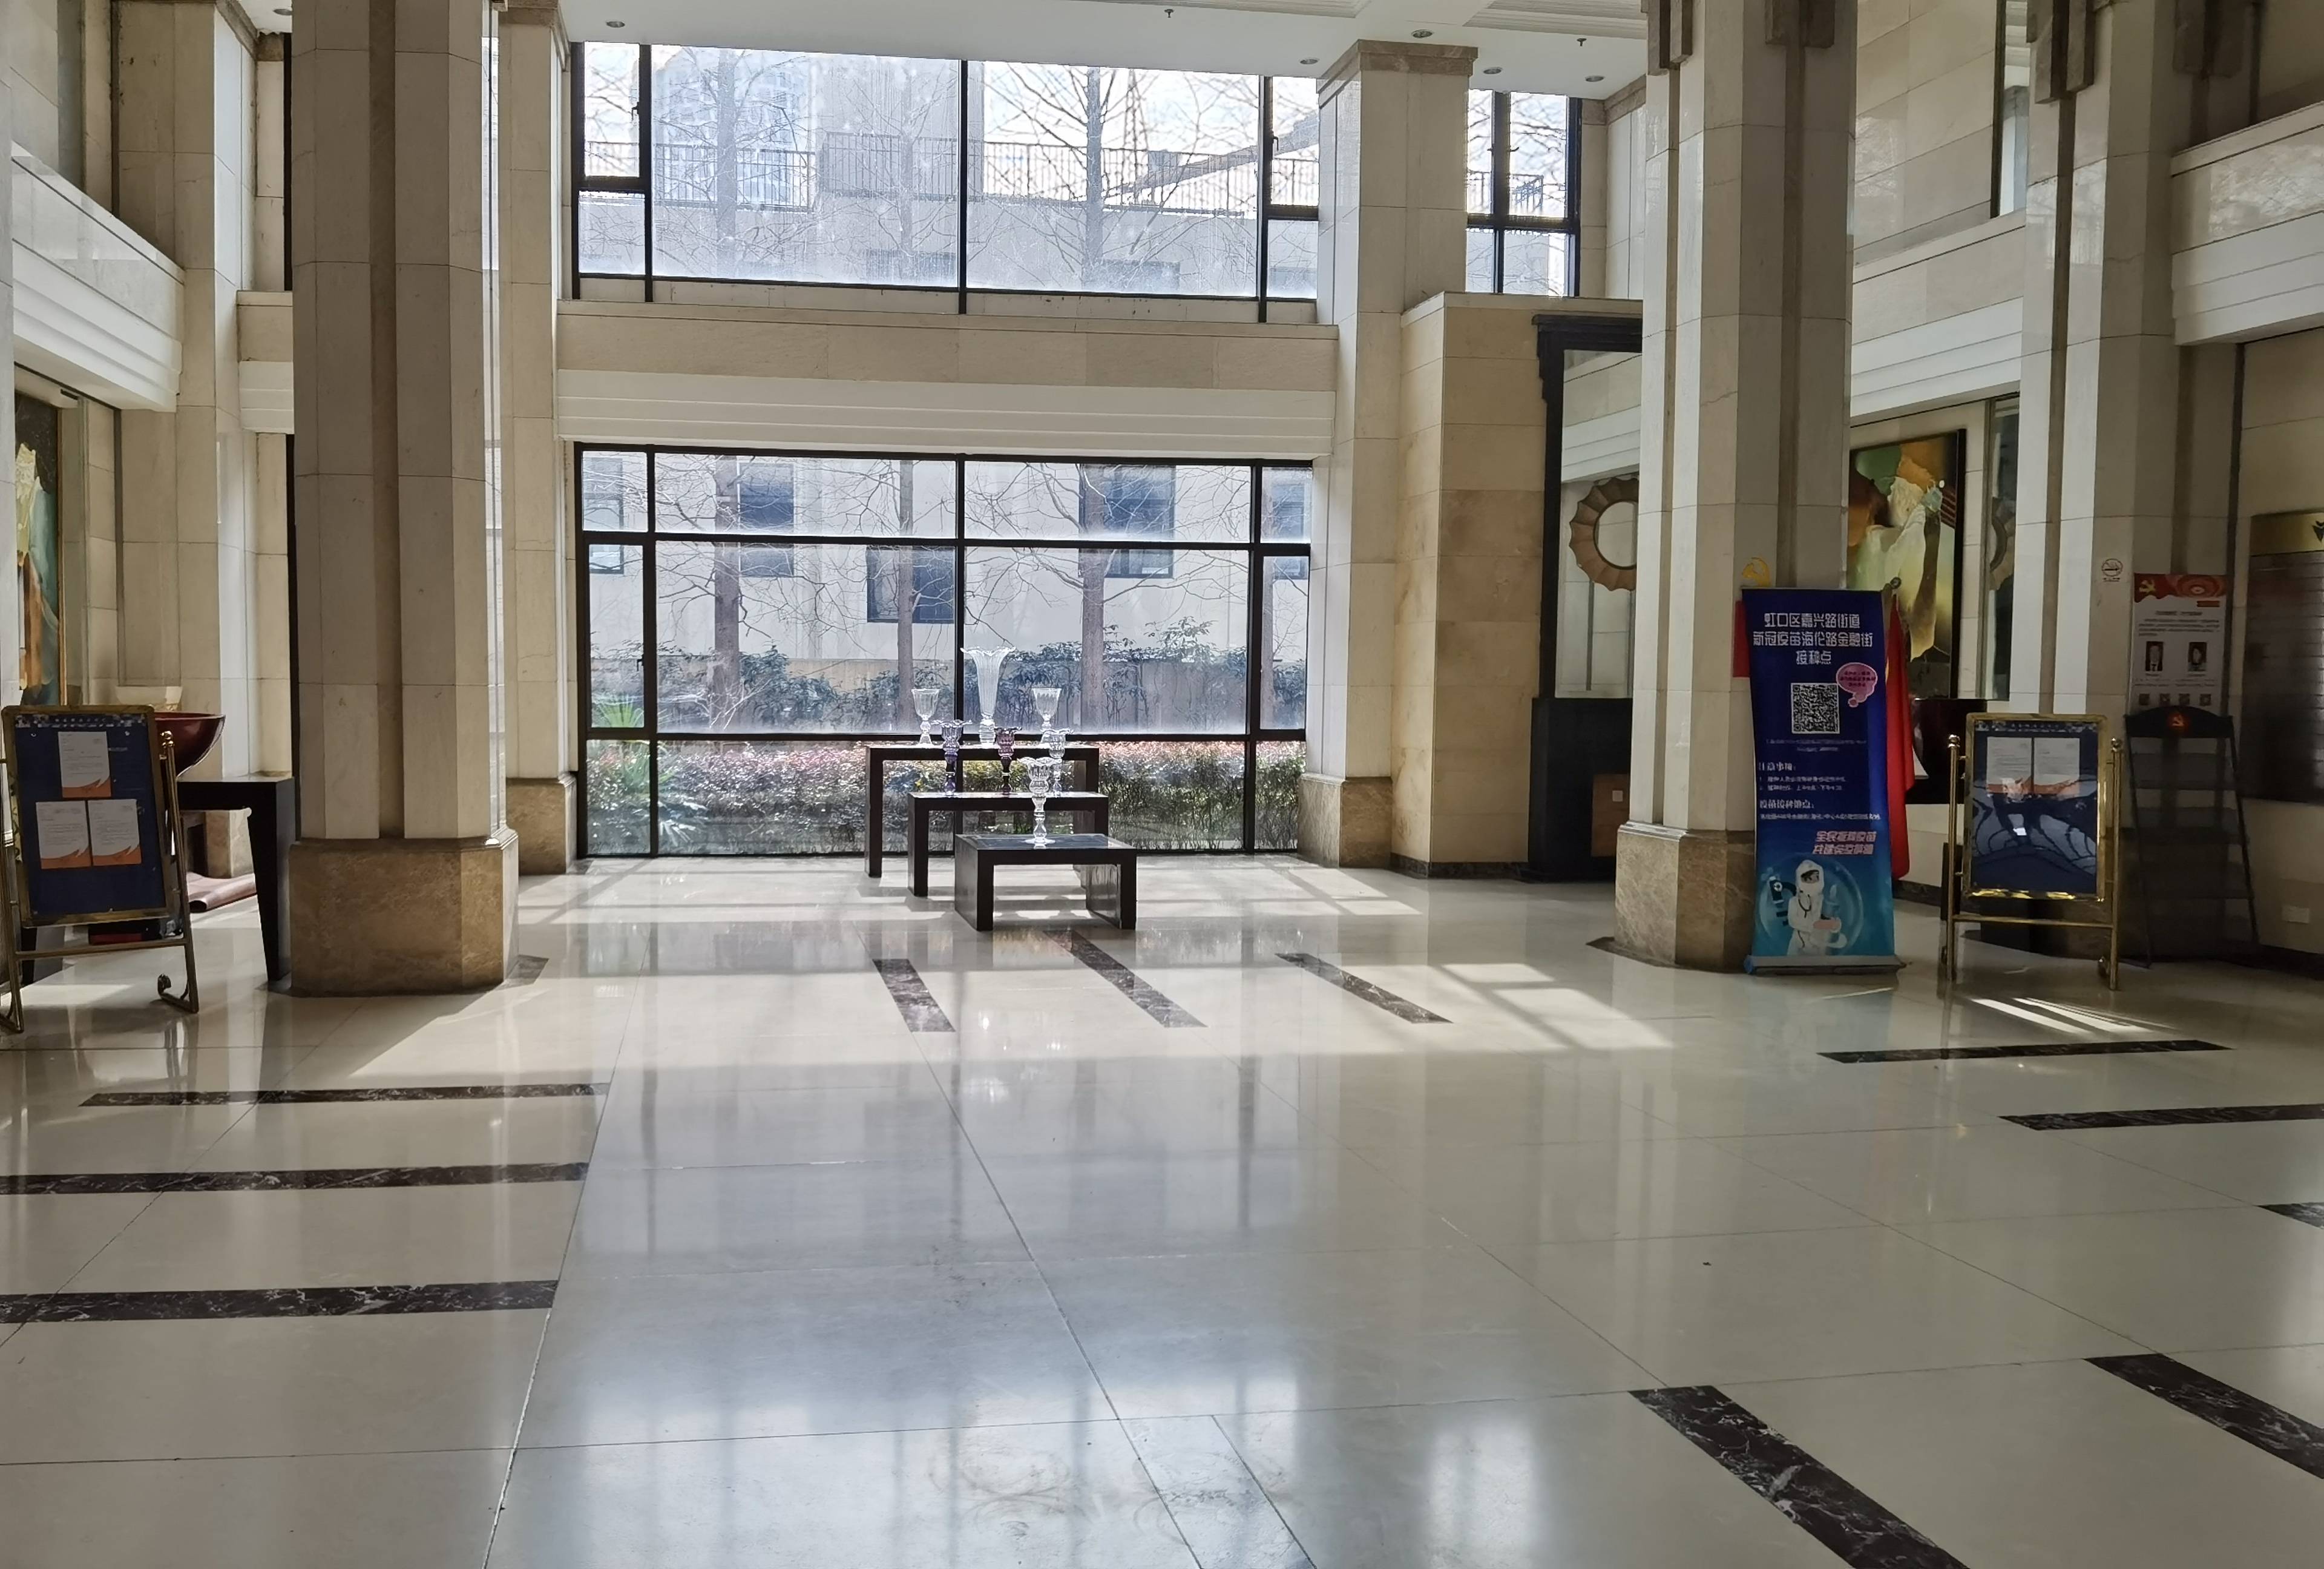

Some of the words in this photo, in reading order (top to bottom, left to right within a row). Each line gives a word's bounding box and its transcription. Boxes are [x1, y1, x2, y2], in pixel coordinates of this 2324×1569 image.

[1764, 613, 1860, 628] 虹口区嘉兴路街道
[1753, 631, 1873, 647] 新冠疫苗海伦路金融街
[1796, 650, 1831, 665] 接种点
